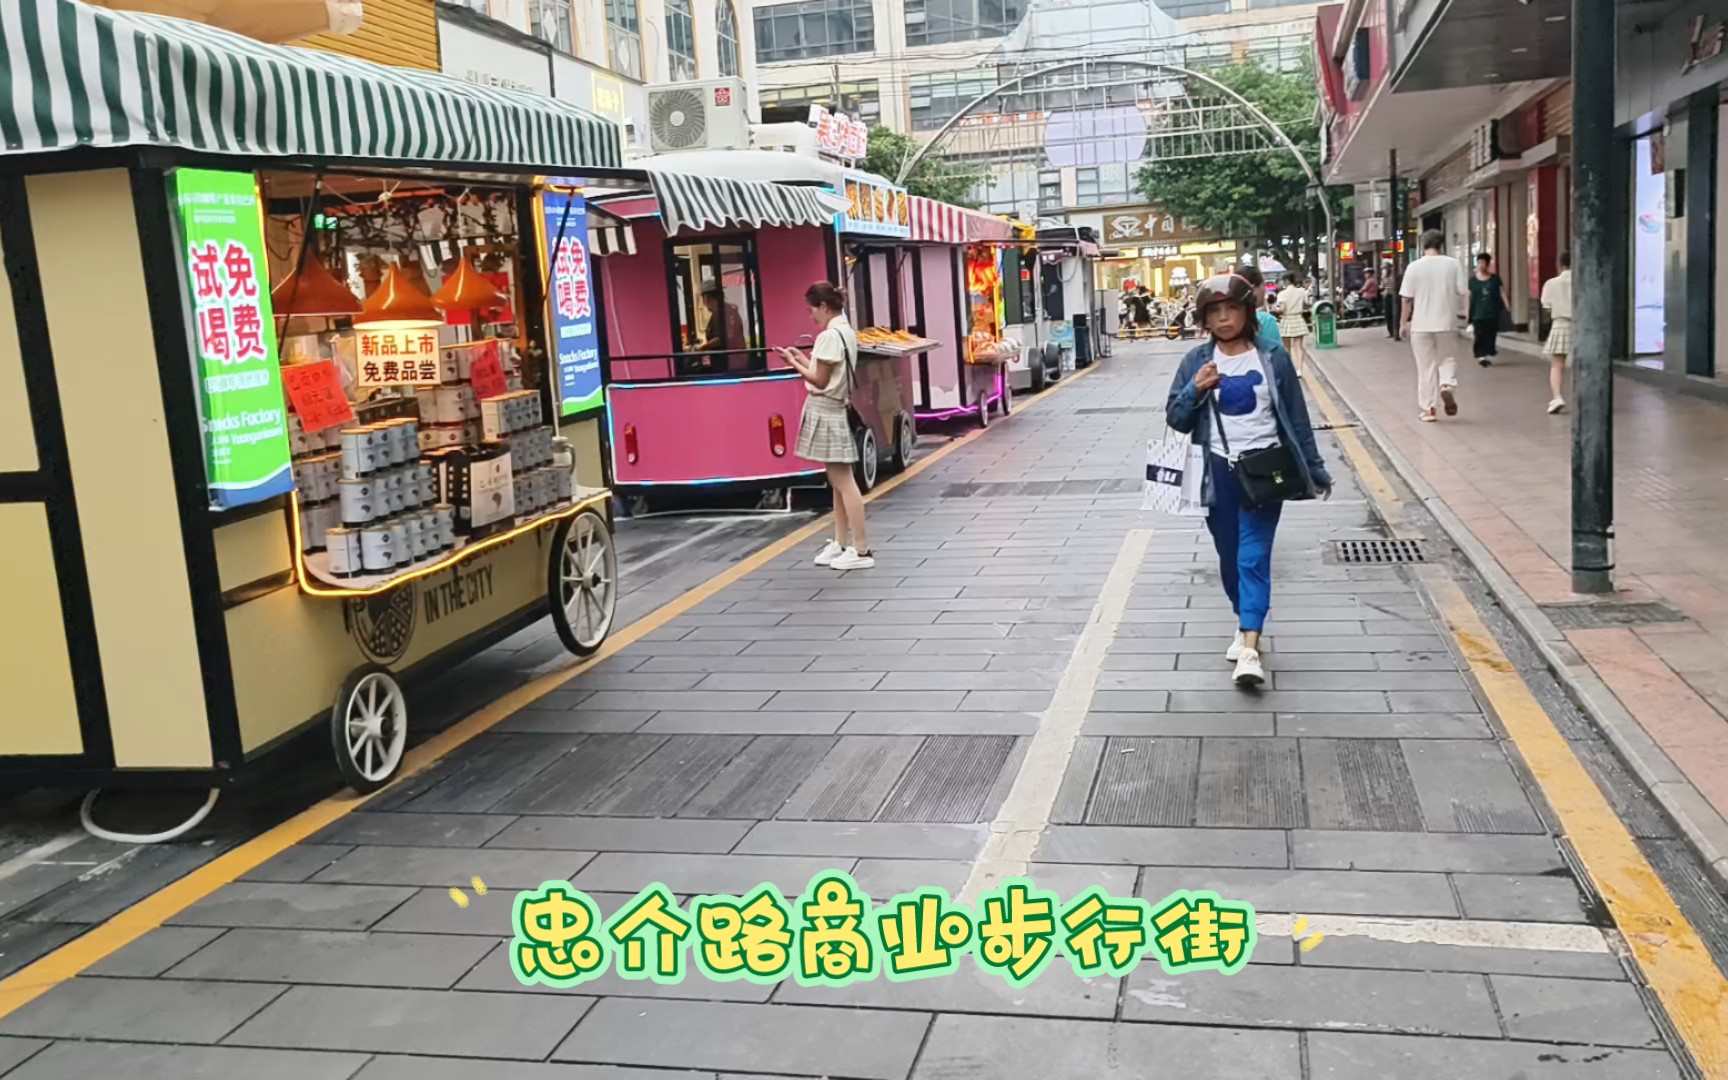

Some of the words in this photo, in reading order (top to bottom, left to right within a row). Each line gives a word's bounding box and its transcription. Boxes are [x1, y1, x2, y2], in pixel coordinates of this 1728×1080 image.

[360, 333, 436, 357] 新品上市
[363, 359, 437, 383] 免费品尝
[240, 407, 281, 428] Factory
[423, 589, 441, 625] IN
[439, 576, 467, 616] THE
[467, 563, 494, 606] CITY
